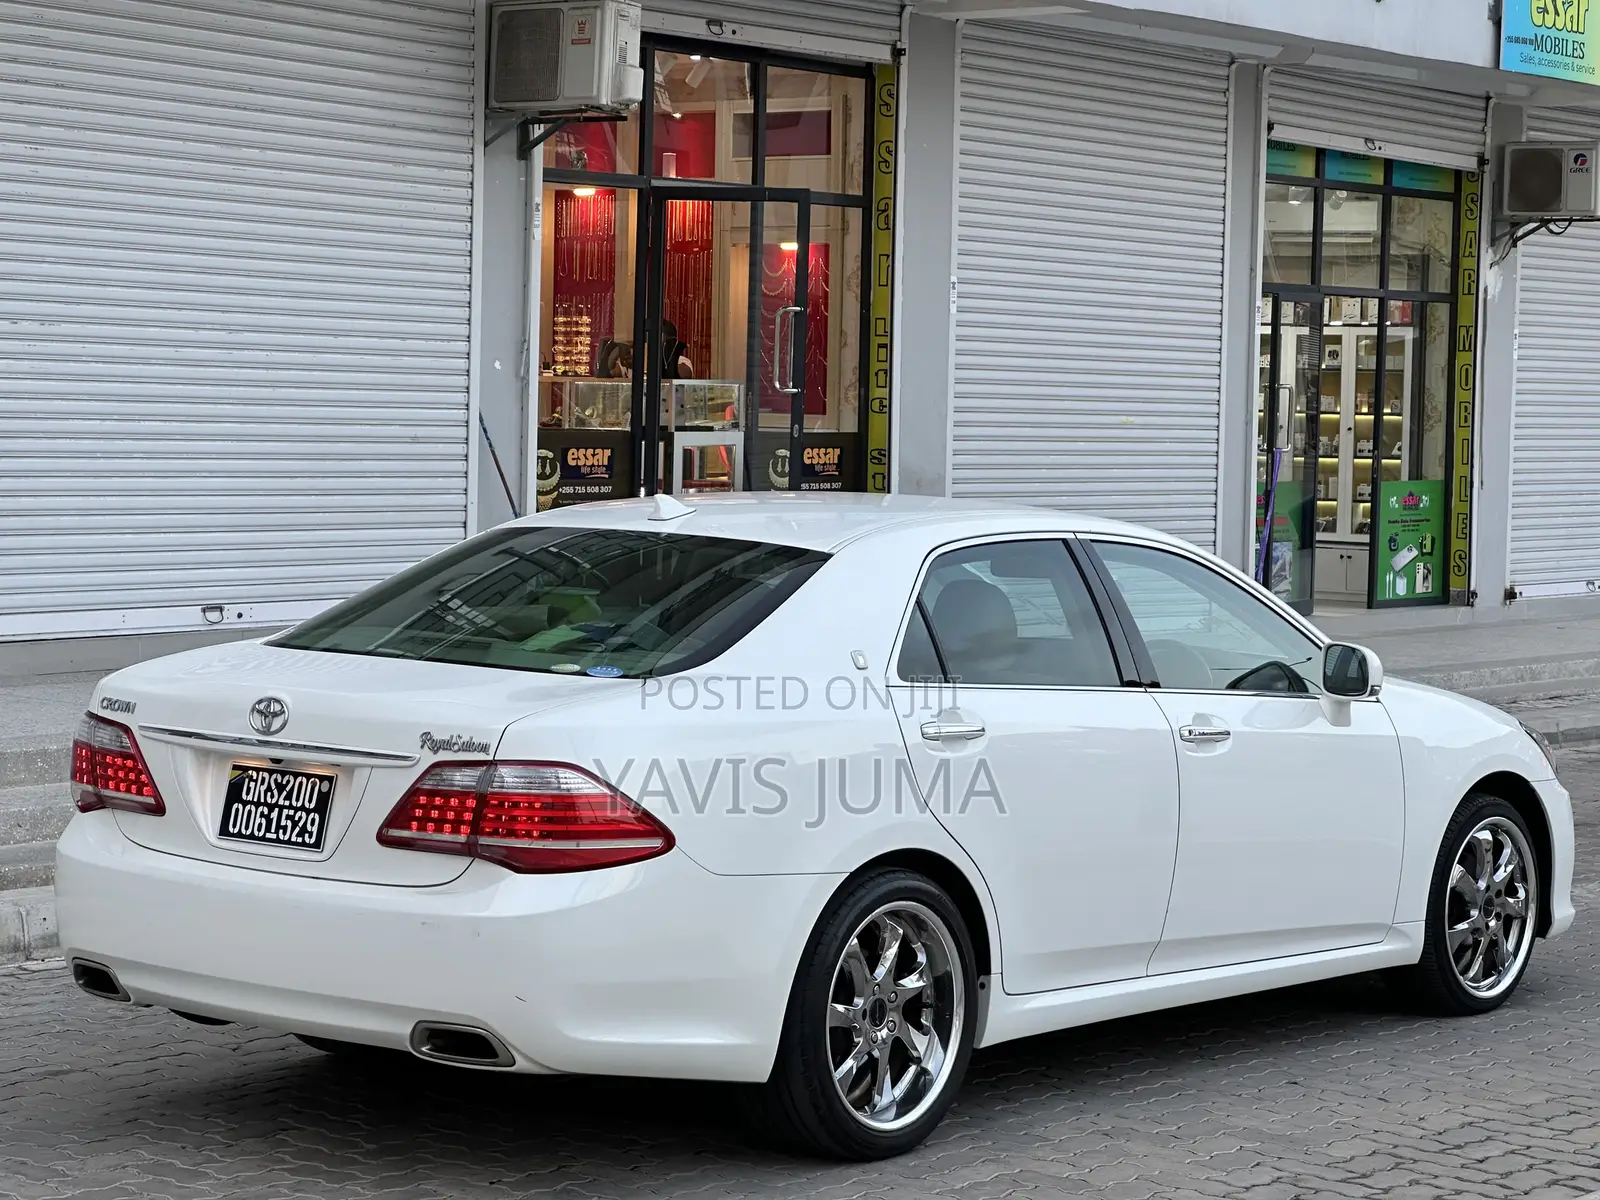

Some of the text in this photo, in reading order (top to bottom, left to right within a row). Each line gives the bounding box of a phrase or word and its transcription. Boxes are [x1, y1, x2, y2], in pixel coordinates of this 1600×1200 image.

[1530, 0, 1589, 34] essar
[1533, 33, 1585, 60] MOBILES
[1519, 52, 1595, 75] Sales, accessories & service
[567, 448, 611, 466] essar
[803, 447, 841, 465] essar
[1453, 325, 1473, 577] MOBILES
[559, 486, 574, 494] +255
[575, 486, 586, 494] 715
[600, 485, 612, 493] 307
[100, 696, 137, 715] CROWN
[242, 770, 320, 809] GRS200
[228, 802, 320, 844] 0061529
